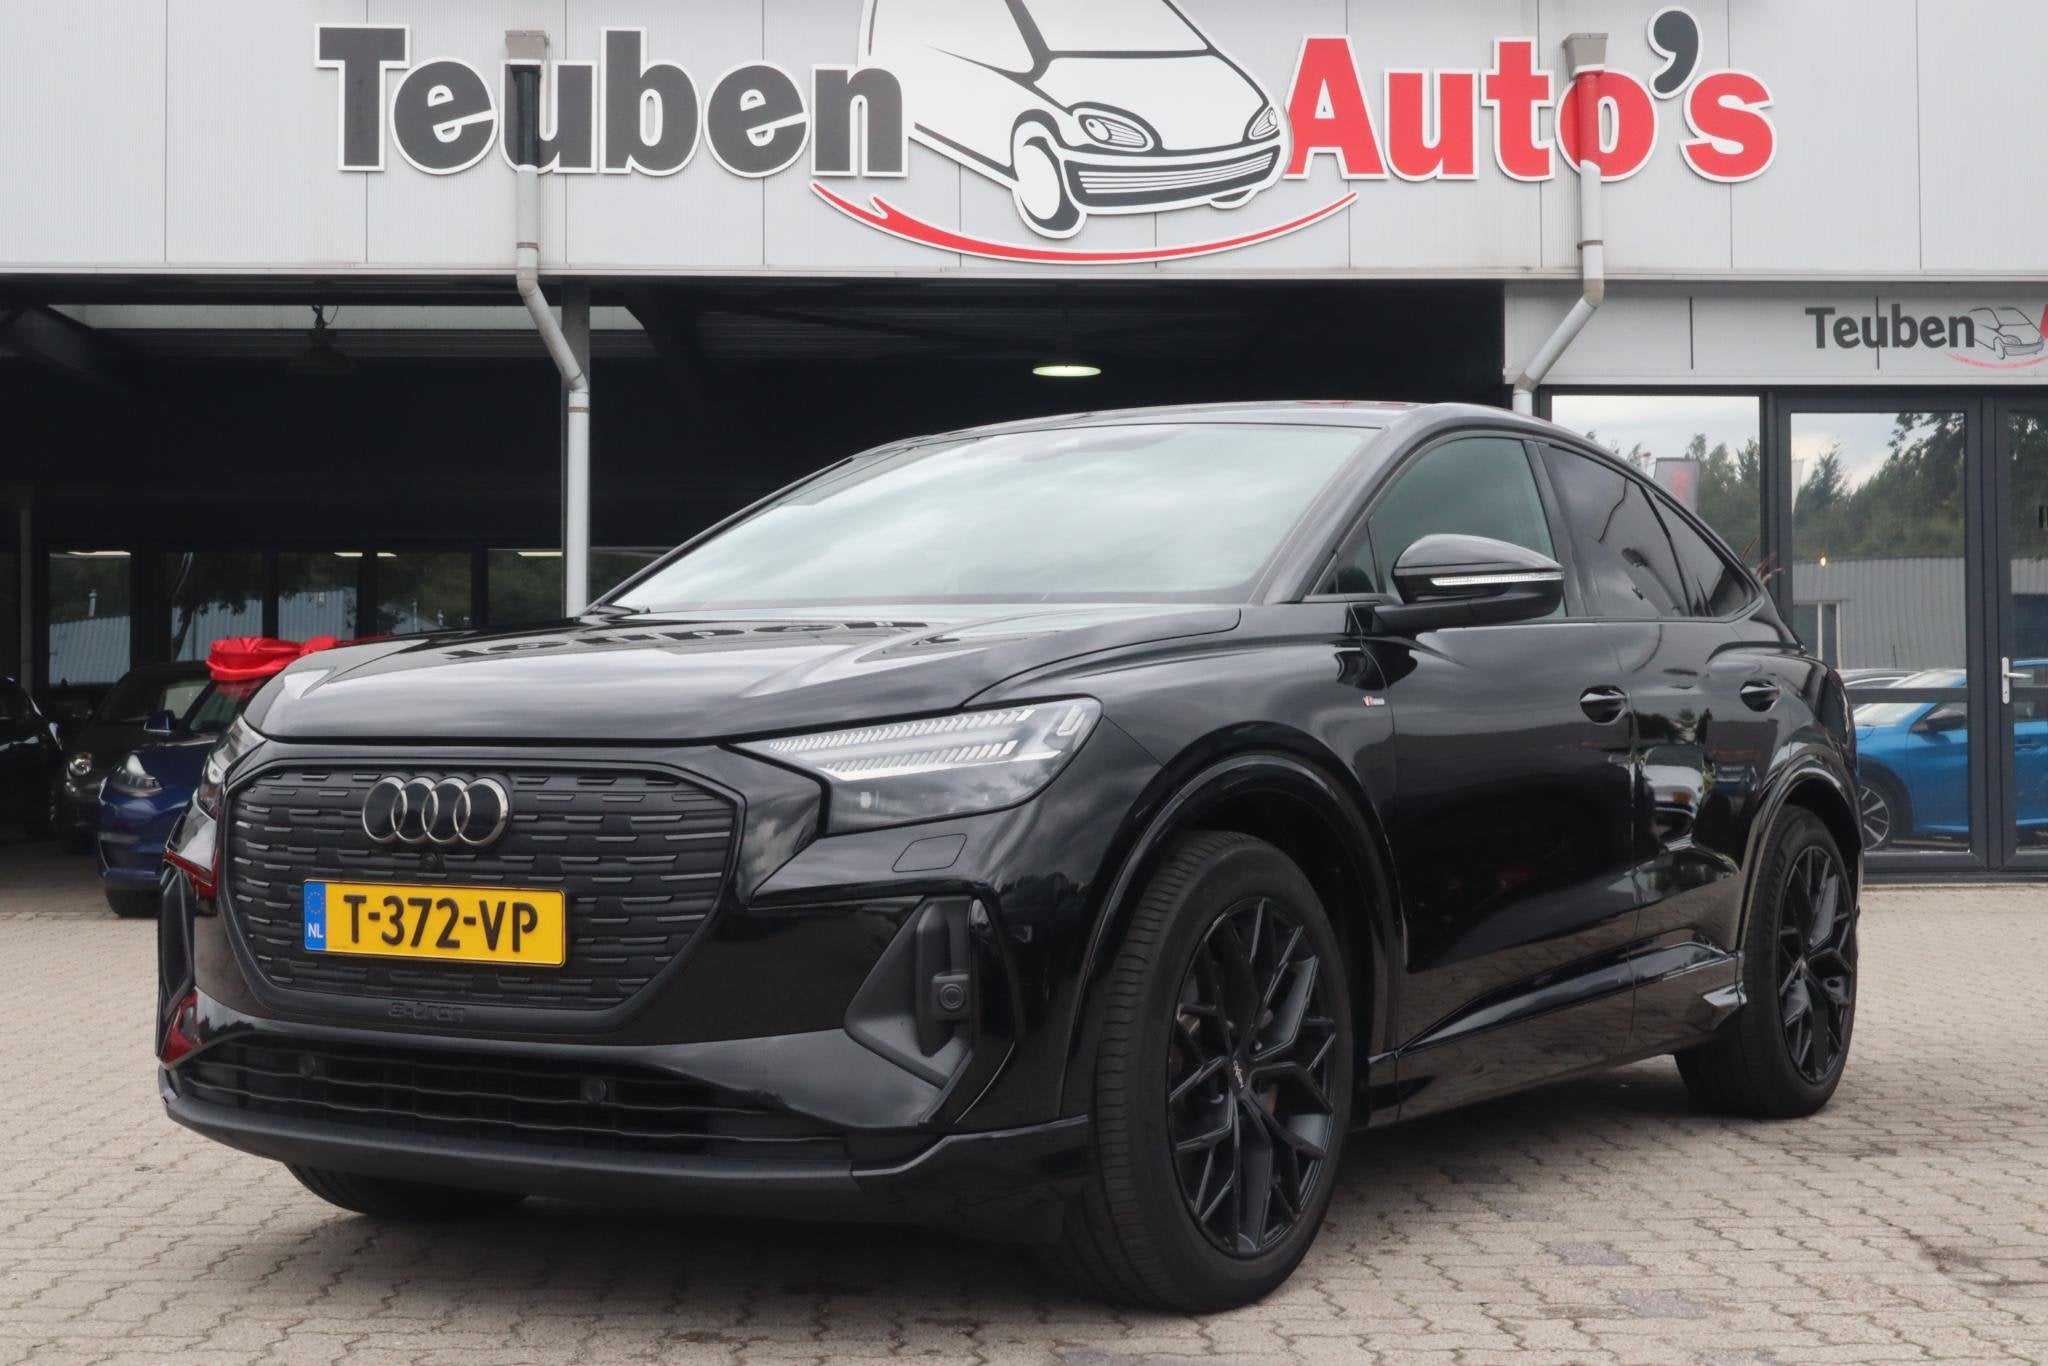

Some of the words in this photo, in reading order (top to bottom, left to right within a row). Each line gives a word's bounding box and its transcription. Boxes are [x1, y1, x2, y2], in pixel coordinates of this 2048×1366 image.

[315, 24, 908, 177] Teuben
[1285, 7, 1777, 182] Auto's
[1805, 303, 1975, 349] Teuben
[308, 923, 324, 938] NL
[343, 894, 538, 952] T-372-VP
